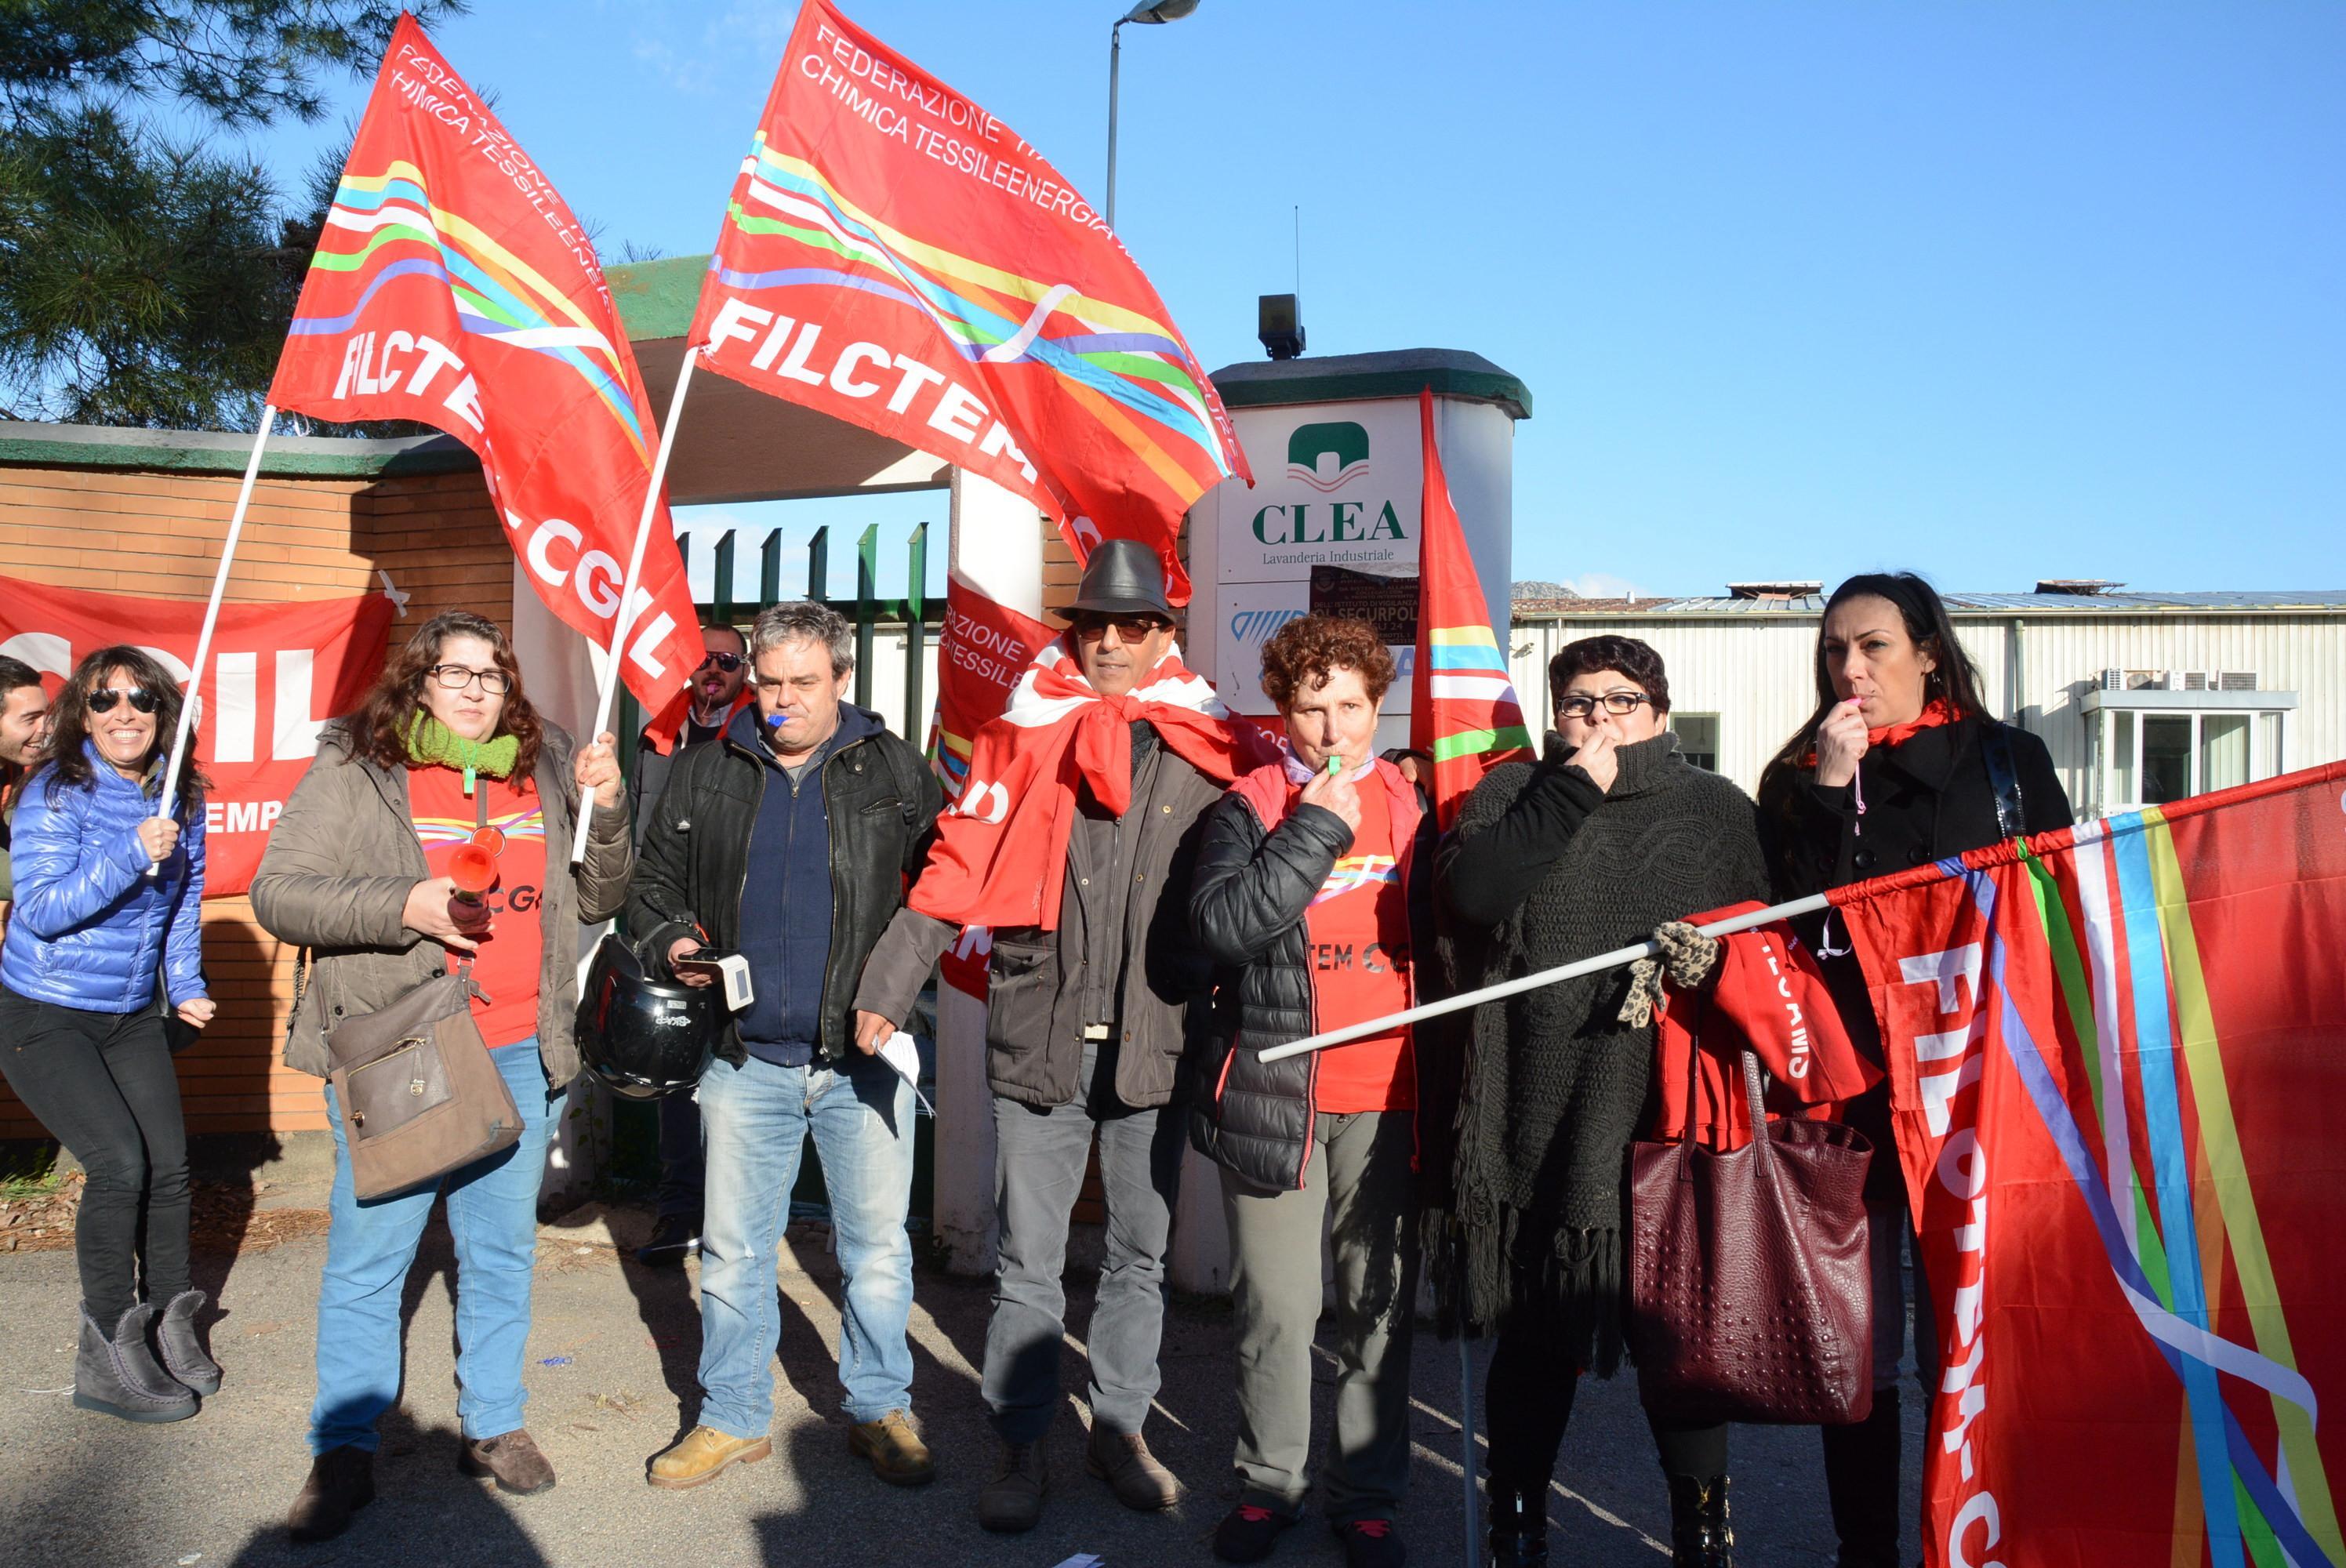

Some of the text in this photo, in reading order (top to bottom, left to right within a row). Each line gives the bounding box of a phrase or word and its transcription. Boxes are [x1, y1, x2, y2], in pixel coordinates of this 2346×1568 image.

[390, 69, 469, 134] HIMICA
[816, 24, 1004, 143] FEDERAZIONE
[801, 54, 1113, 241] CHIMICA TESSILEENERGIA
[708, 296, 1038, 485] FILCTEM
[1252, 499, 1409, 546] CLEA
[1262, 548, 1394, 565] Lavanderia Industriale
[946, 603, 1025, 662] RAZIONE
[1338, 607, 1418, 622] SECURPOL
[205, 800, 283, 833] EMP
